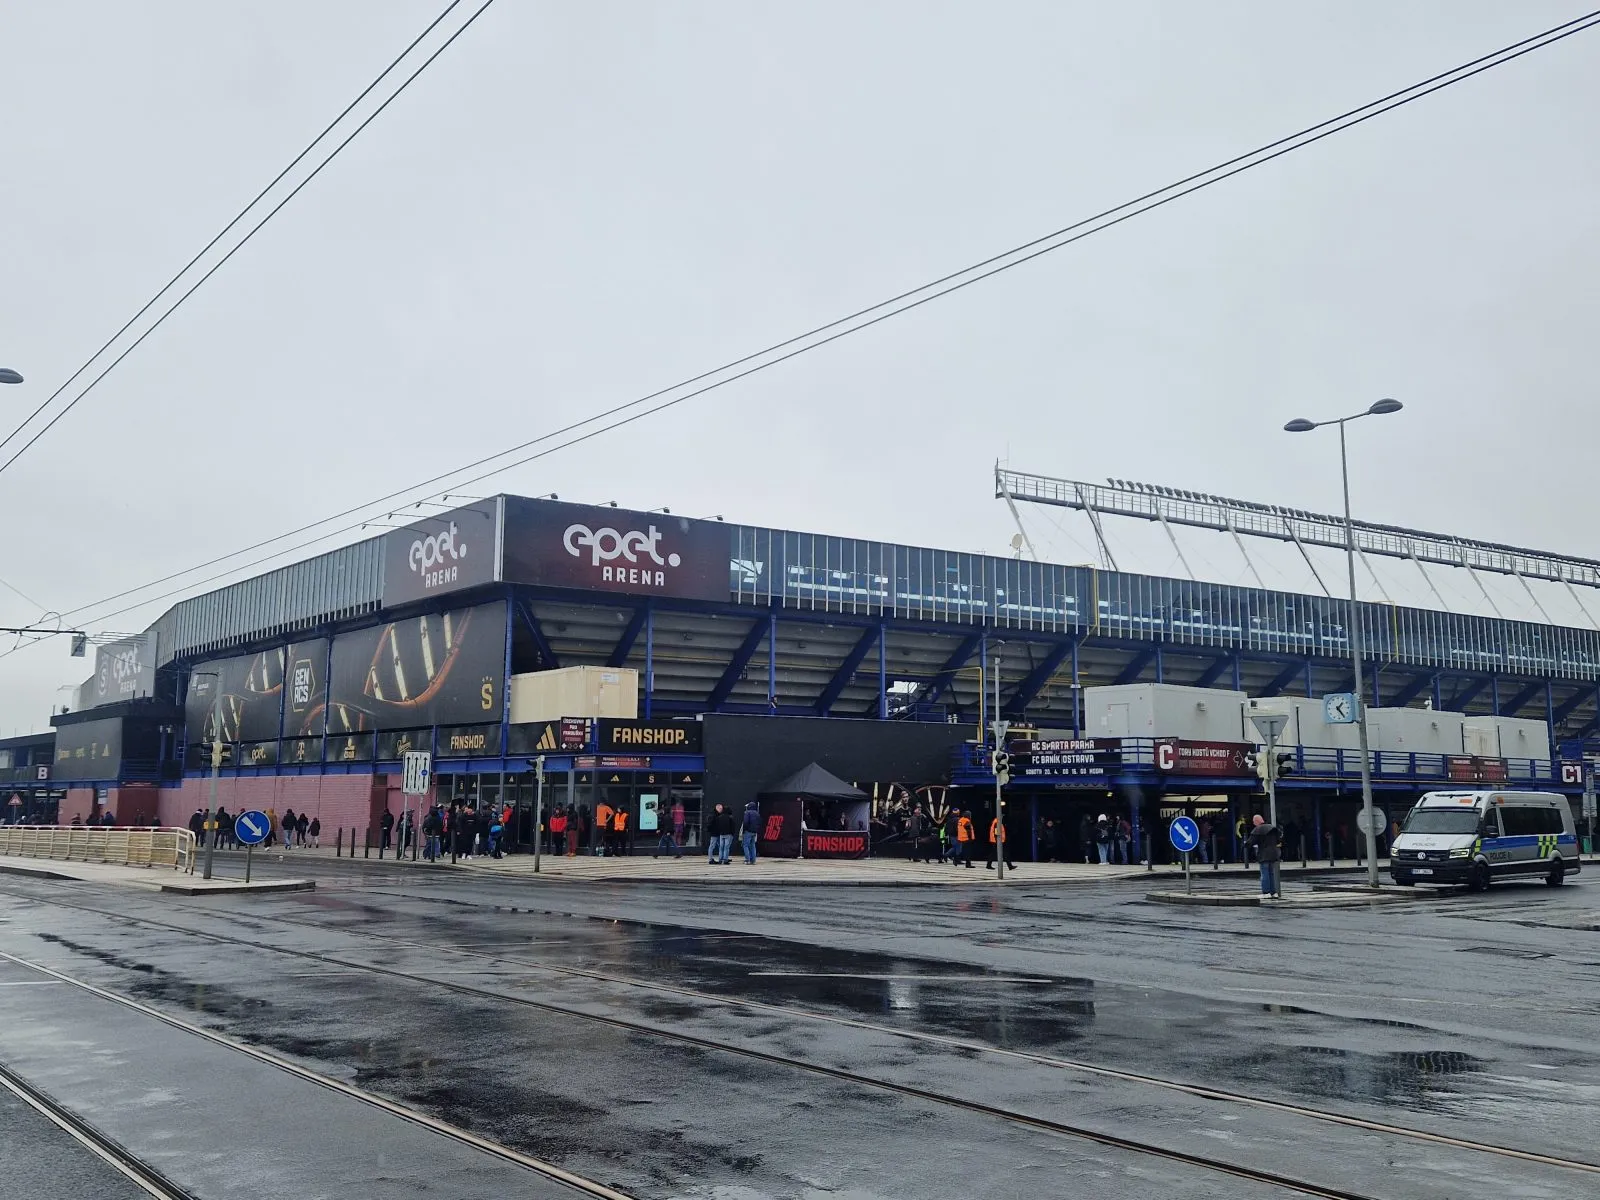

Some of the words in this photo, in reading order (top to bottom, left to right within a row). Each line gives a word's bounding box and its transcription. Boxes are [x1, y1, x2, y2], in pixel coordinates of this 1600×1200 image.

[563, 523, 681, 567] epet.
[425, 566, 458, 588] ARENA
[602, 566, 665, 586] ARENA
[294, 667, 310, 686] GEN
[294, 685, 309, 703] ACS
[450, 734, 486, 750] FANSHOP.
[612, 727, 689, 745] FANSHOP.
[1031, 741, 1041, 751] AC
[1041, 740, 1069, 751] SPARTA
[1070, 739, 1095, 750] PRAHA
[1031, 755, 1040, 764] FC
[1040, 753, 1061, 764] BANÍK
[1062, 754, 1095, 764] OSTRAVA
[1159, 744, 1174, 770] C
[37, 767, 48, 780] B
[1561, 765, 1583, 783] C1
[807, 835, 865, 852] FANSHOP.
